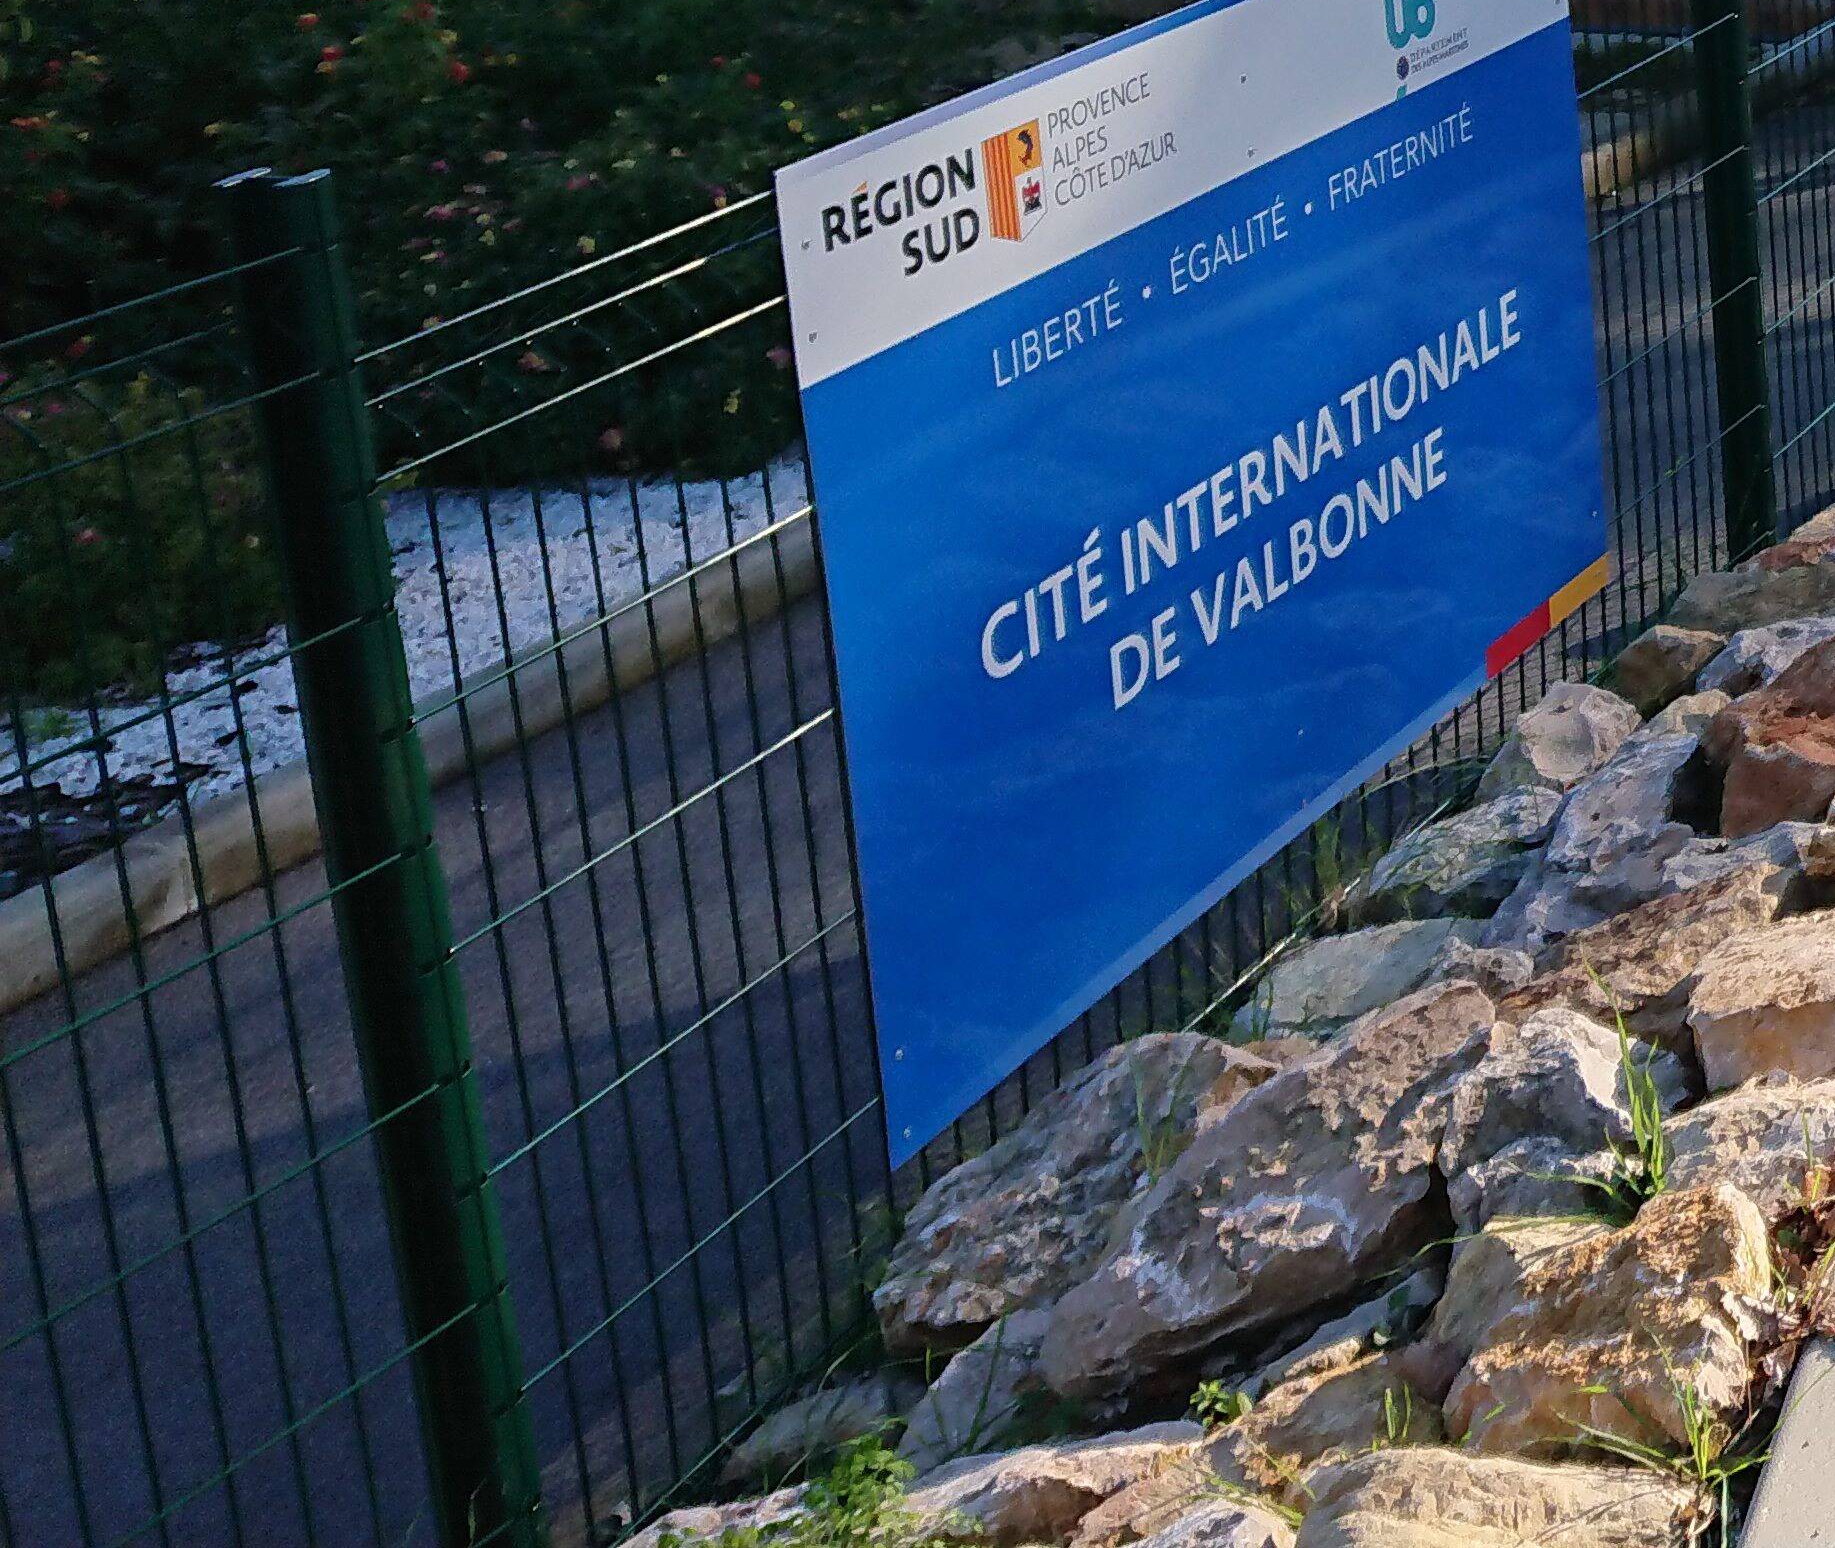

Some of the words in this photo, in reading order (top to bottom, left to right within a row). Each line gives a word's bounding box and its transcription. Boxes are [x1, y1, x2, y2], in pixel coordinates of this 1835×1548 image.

[1047, 71, 1152, 139] PROVENCE
[1051, 126, 1109, 174] ALPES
[821, 147, 977, 253] RÉGION
[1054, 163, 1110, 206] CÔTE
[1111, 131, 1178, 181] D'AZUR
[901, 207, 980, 278] SUD
[991, 277, 1125, 389] LIBERTÉ
[1169, 195, 1290, 296] ÉGALITÉ
[1328, 101, 1476, 212] FRATERNITÉ
[981, 525, 1108, 679] CITÉ
[1120, 286, 1522, 597] INTERNATIONALE
[1108, 605, 1182, 712] DE
[1190, 426, 1450, 647] VALBONNE
